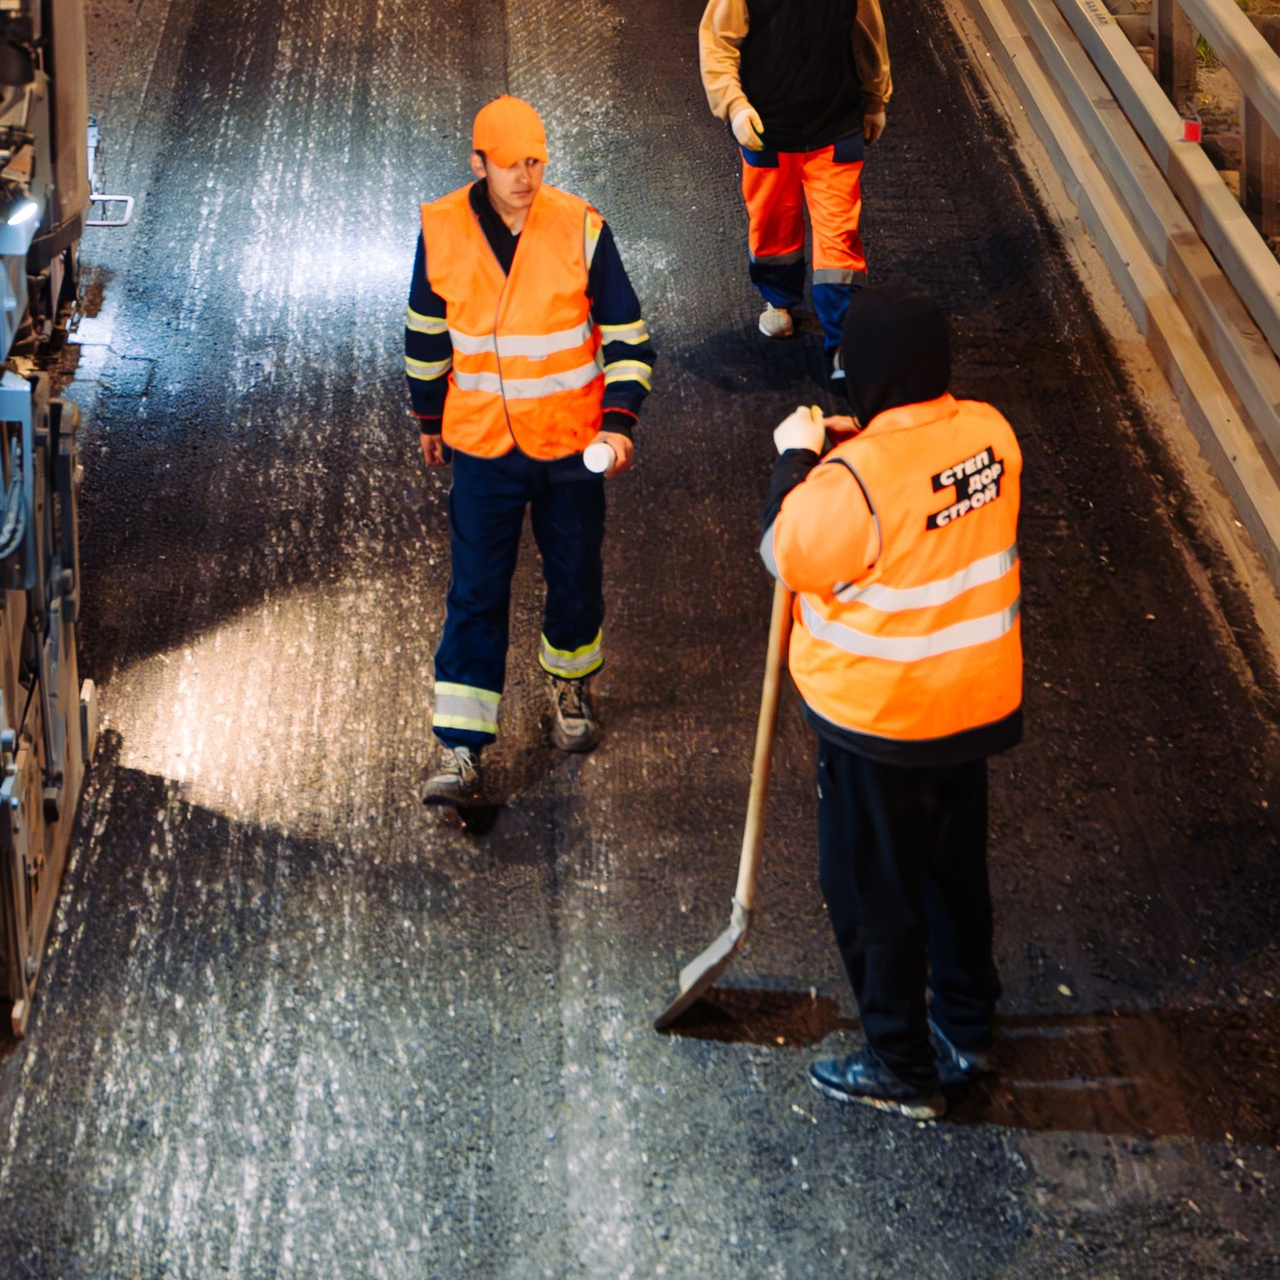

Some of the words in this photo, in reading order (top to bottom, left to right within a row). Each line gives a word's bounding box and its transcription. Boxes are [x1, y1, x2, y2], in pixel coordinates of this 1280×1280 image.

[940, 450, 989, 486] СТЕП
[967, 462, 1002, 495] ДОР
[936, 482, 997, 527] СТРОЙ
